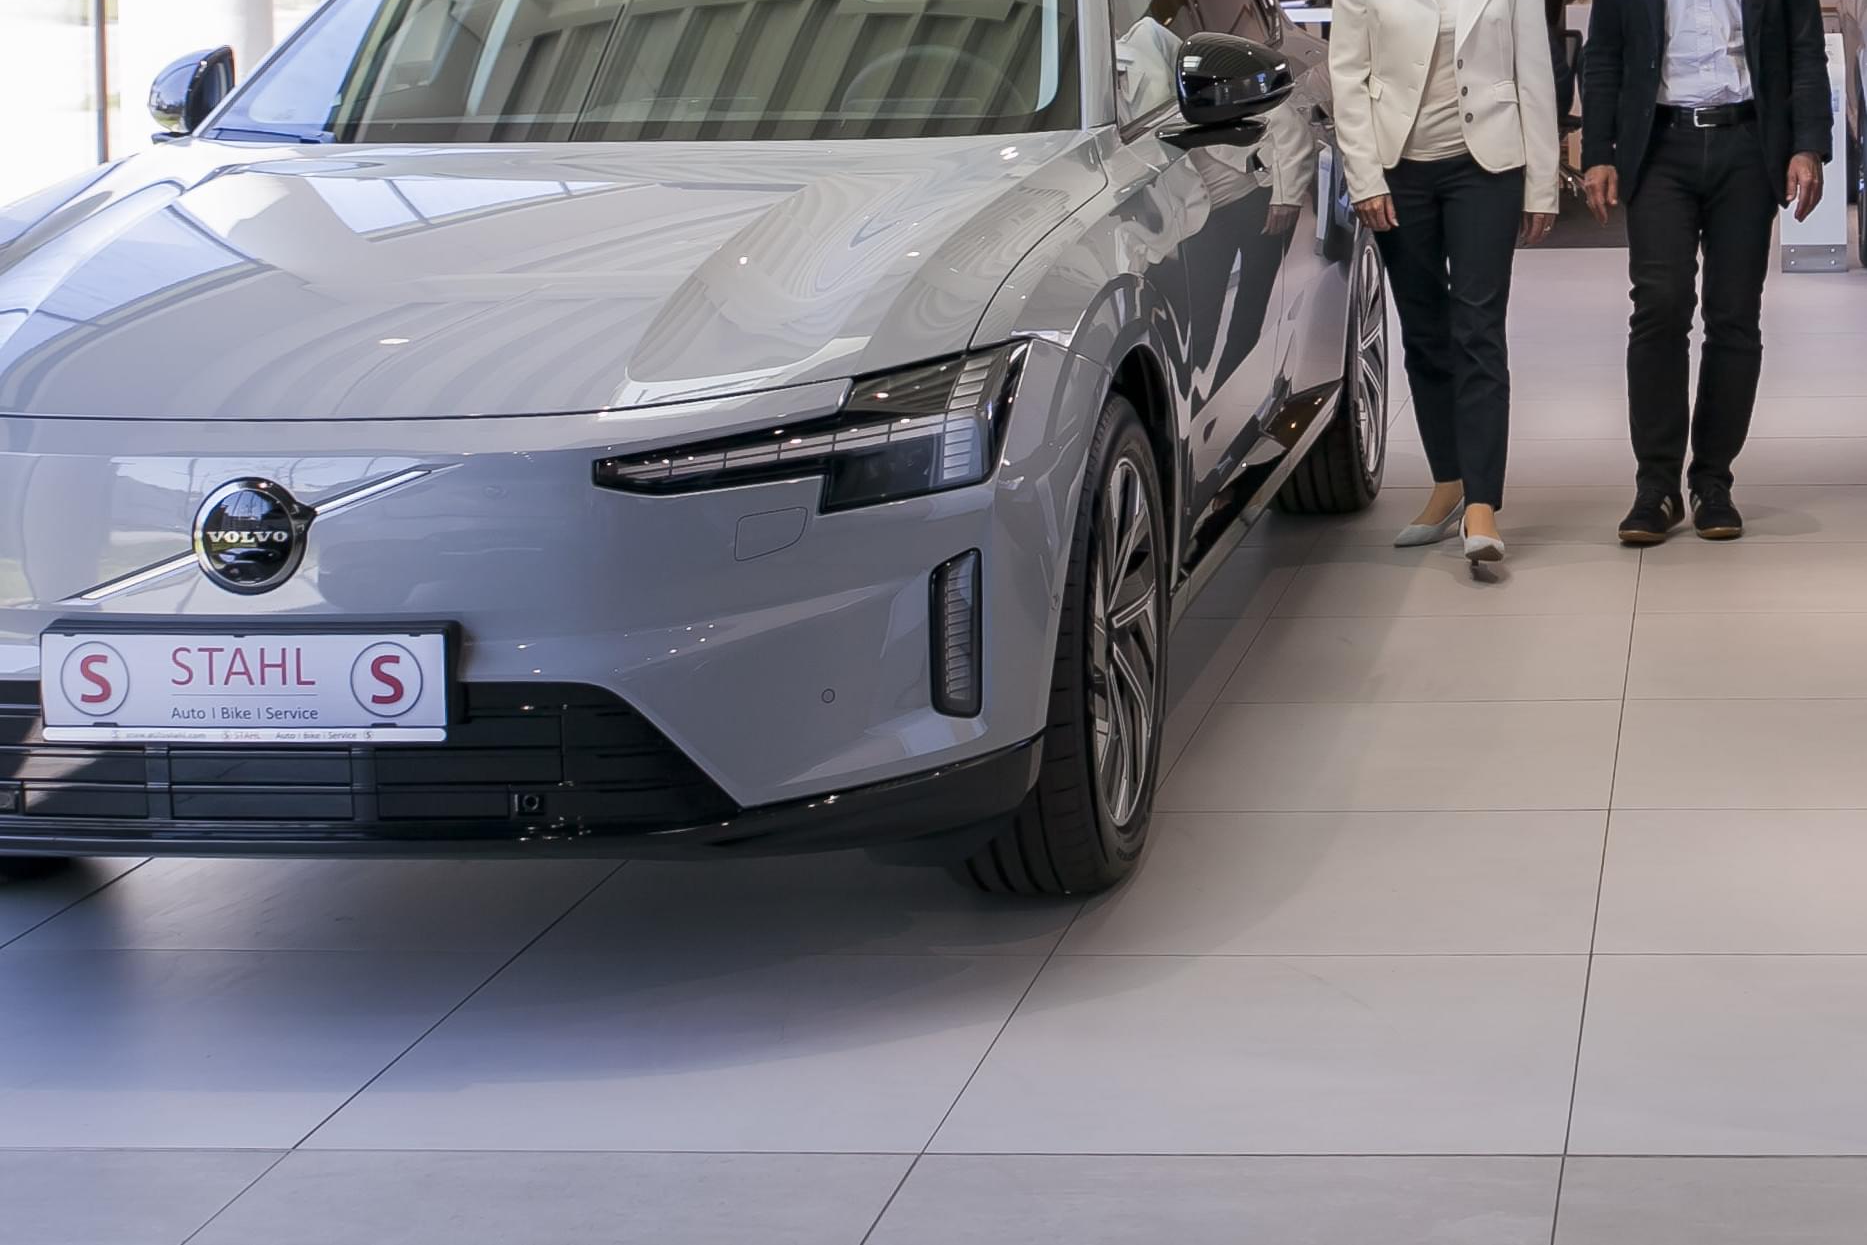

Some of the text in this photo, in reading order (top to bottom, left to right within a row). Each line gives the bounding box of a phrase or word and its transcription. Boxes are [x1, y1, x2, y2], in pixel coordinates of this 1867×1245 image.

[206, 530, 288, 544] VOLVO
[79, 654, 112, 704] S
[171, 647, 316, 687] STAHL
[370, 654, 405, 705] S
[171, 707, 206, 721] Auto
[221, 707, 252, 721] Bike
[266, 707, 319, 721] Service
[275, 730, 296, 740] Auto
[327, 730, 357, 740] Service
